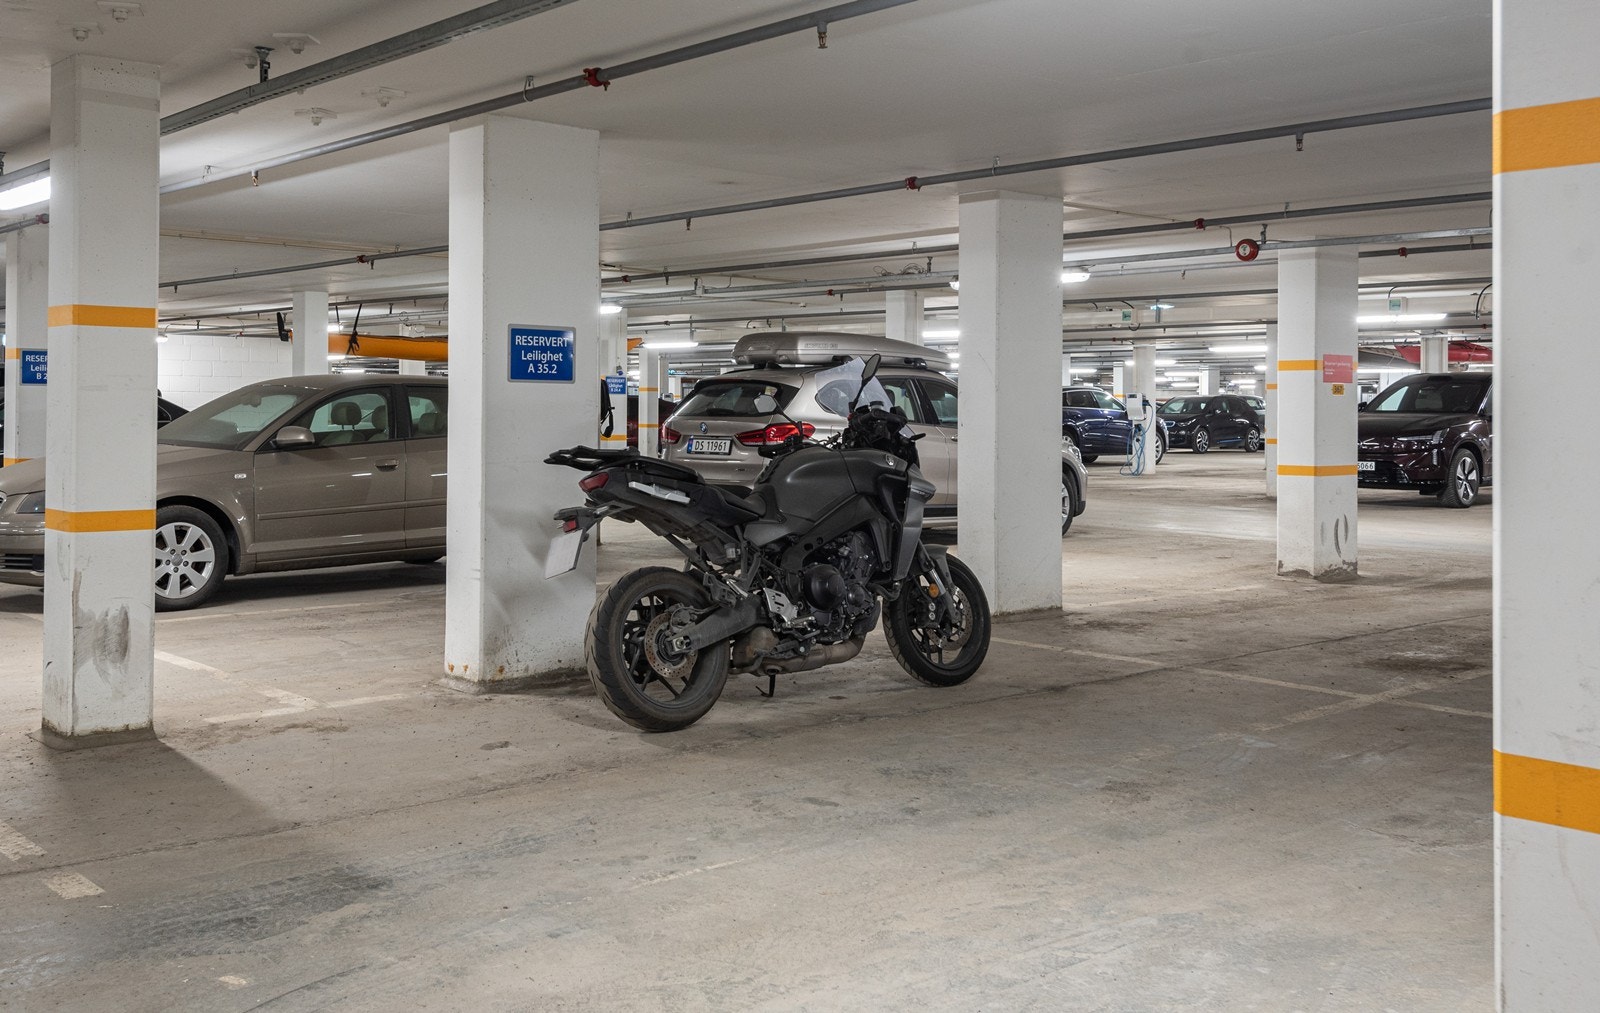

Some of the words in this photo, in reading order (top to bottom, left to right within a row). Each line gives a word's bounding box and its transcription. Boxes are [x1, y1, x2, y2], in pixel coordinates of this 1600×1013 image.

[515, 335, 569, 347] RESERVERT
[521, 350, 563, 364] Leilighet
[527, 363, 535, 373] A
[537, 363, 557, 374] 35.2
[695, 441, 704, 451] DS
[707, 441, 727, 451] 11961
